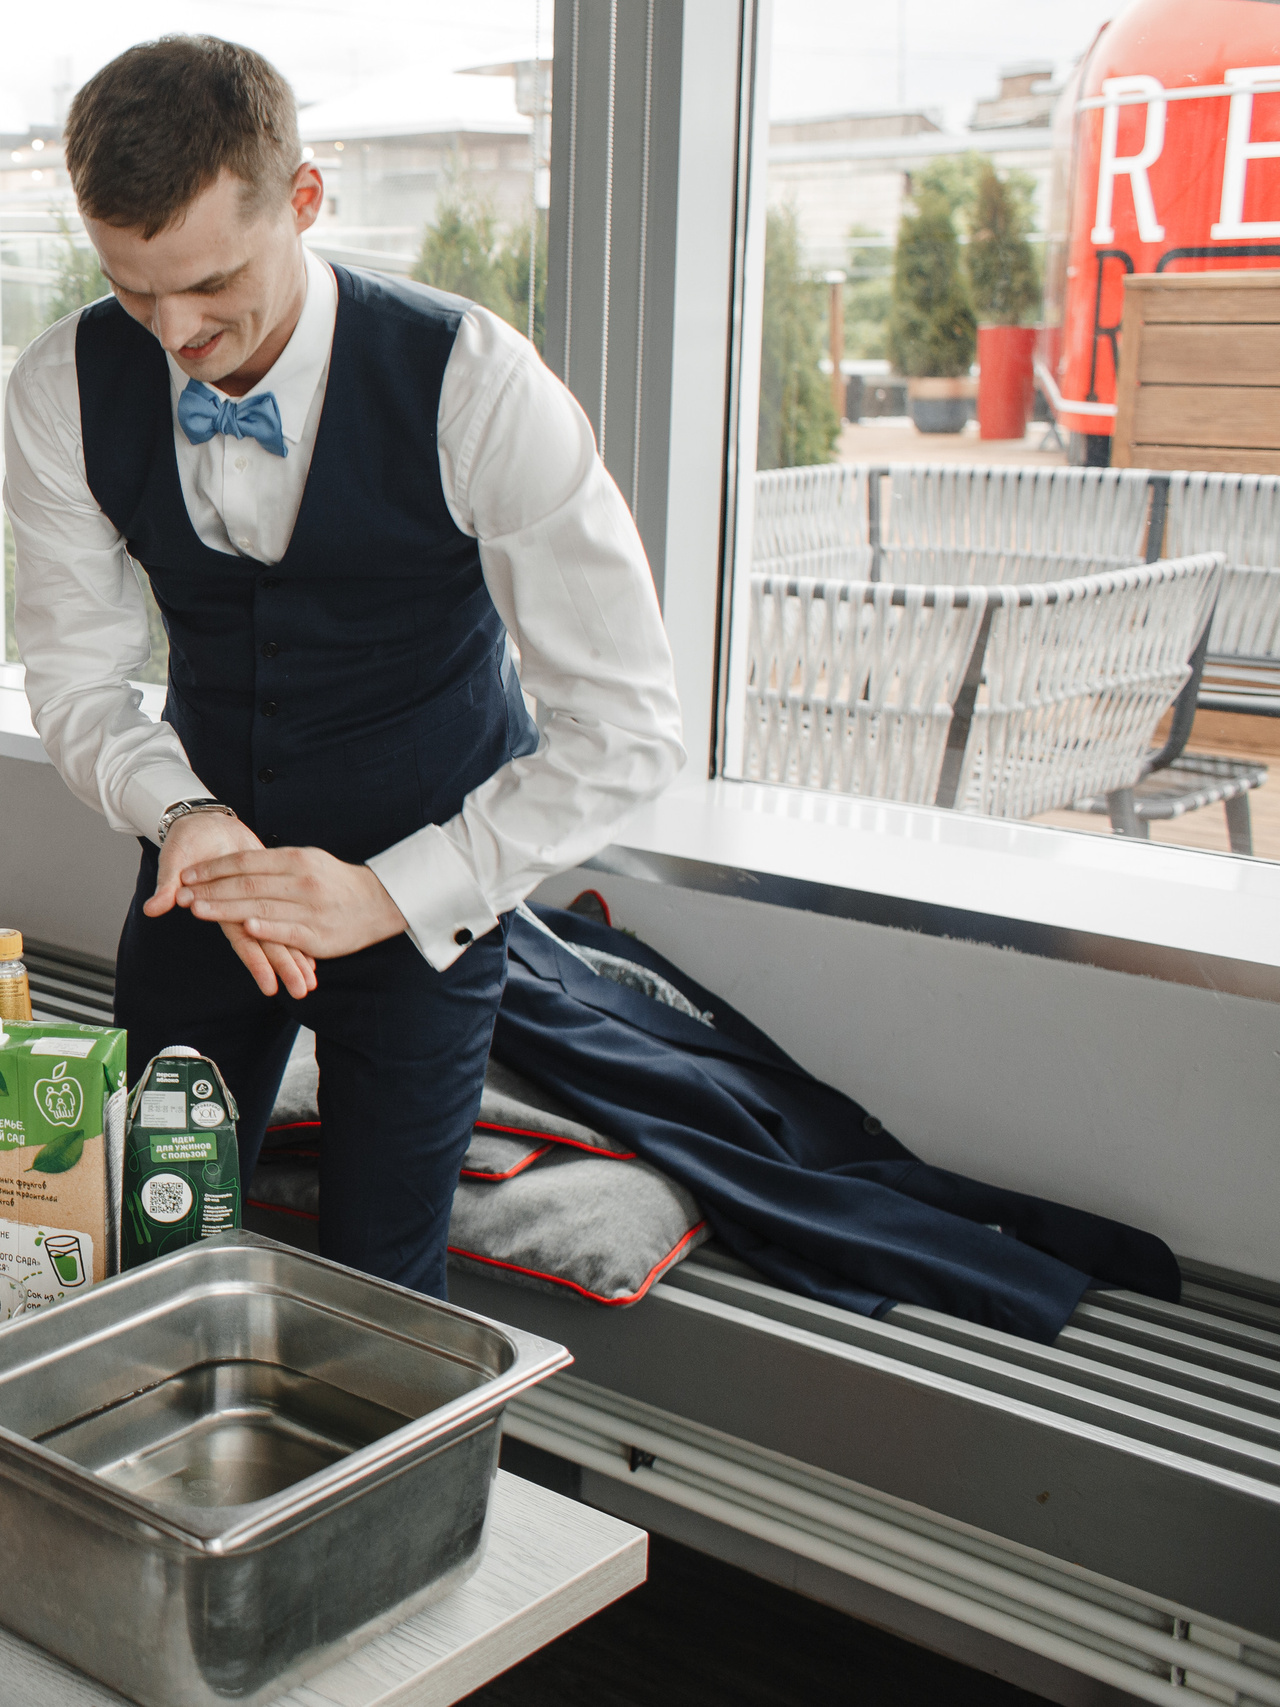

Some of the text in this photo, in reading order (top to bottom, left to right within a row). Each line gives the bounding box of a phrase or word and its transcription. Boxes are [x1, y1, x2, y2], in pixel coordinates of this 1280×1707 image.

[7, 1132, 26, 1146] САД
[171, 1135, 195, 1144] ИДЕИ
[156, 1142, 212, 1154] ДЛЯ УЖИНОВ
[161, 1150, 207, 1160] С ПОЛЬЗОЙ
[16, 1179, 47, 1190] фруктов
[16, 1190, 58, 1202] красителей
[26, 1288, 43, 1299] Сок
[44, 1294, 55, 1304] из
